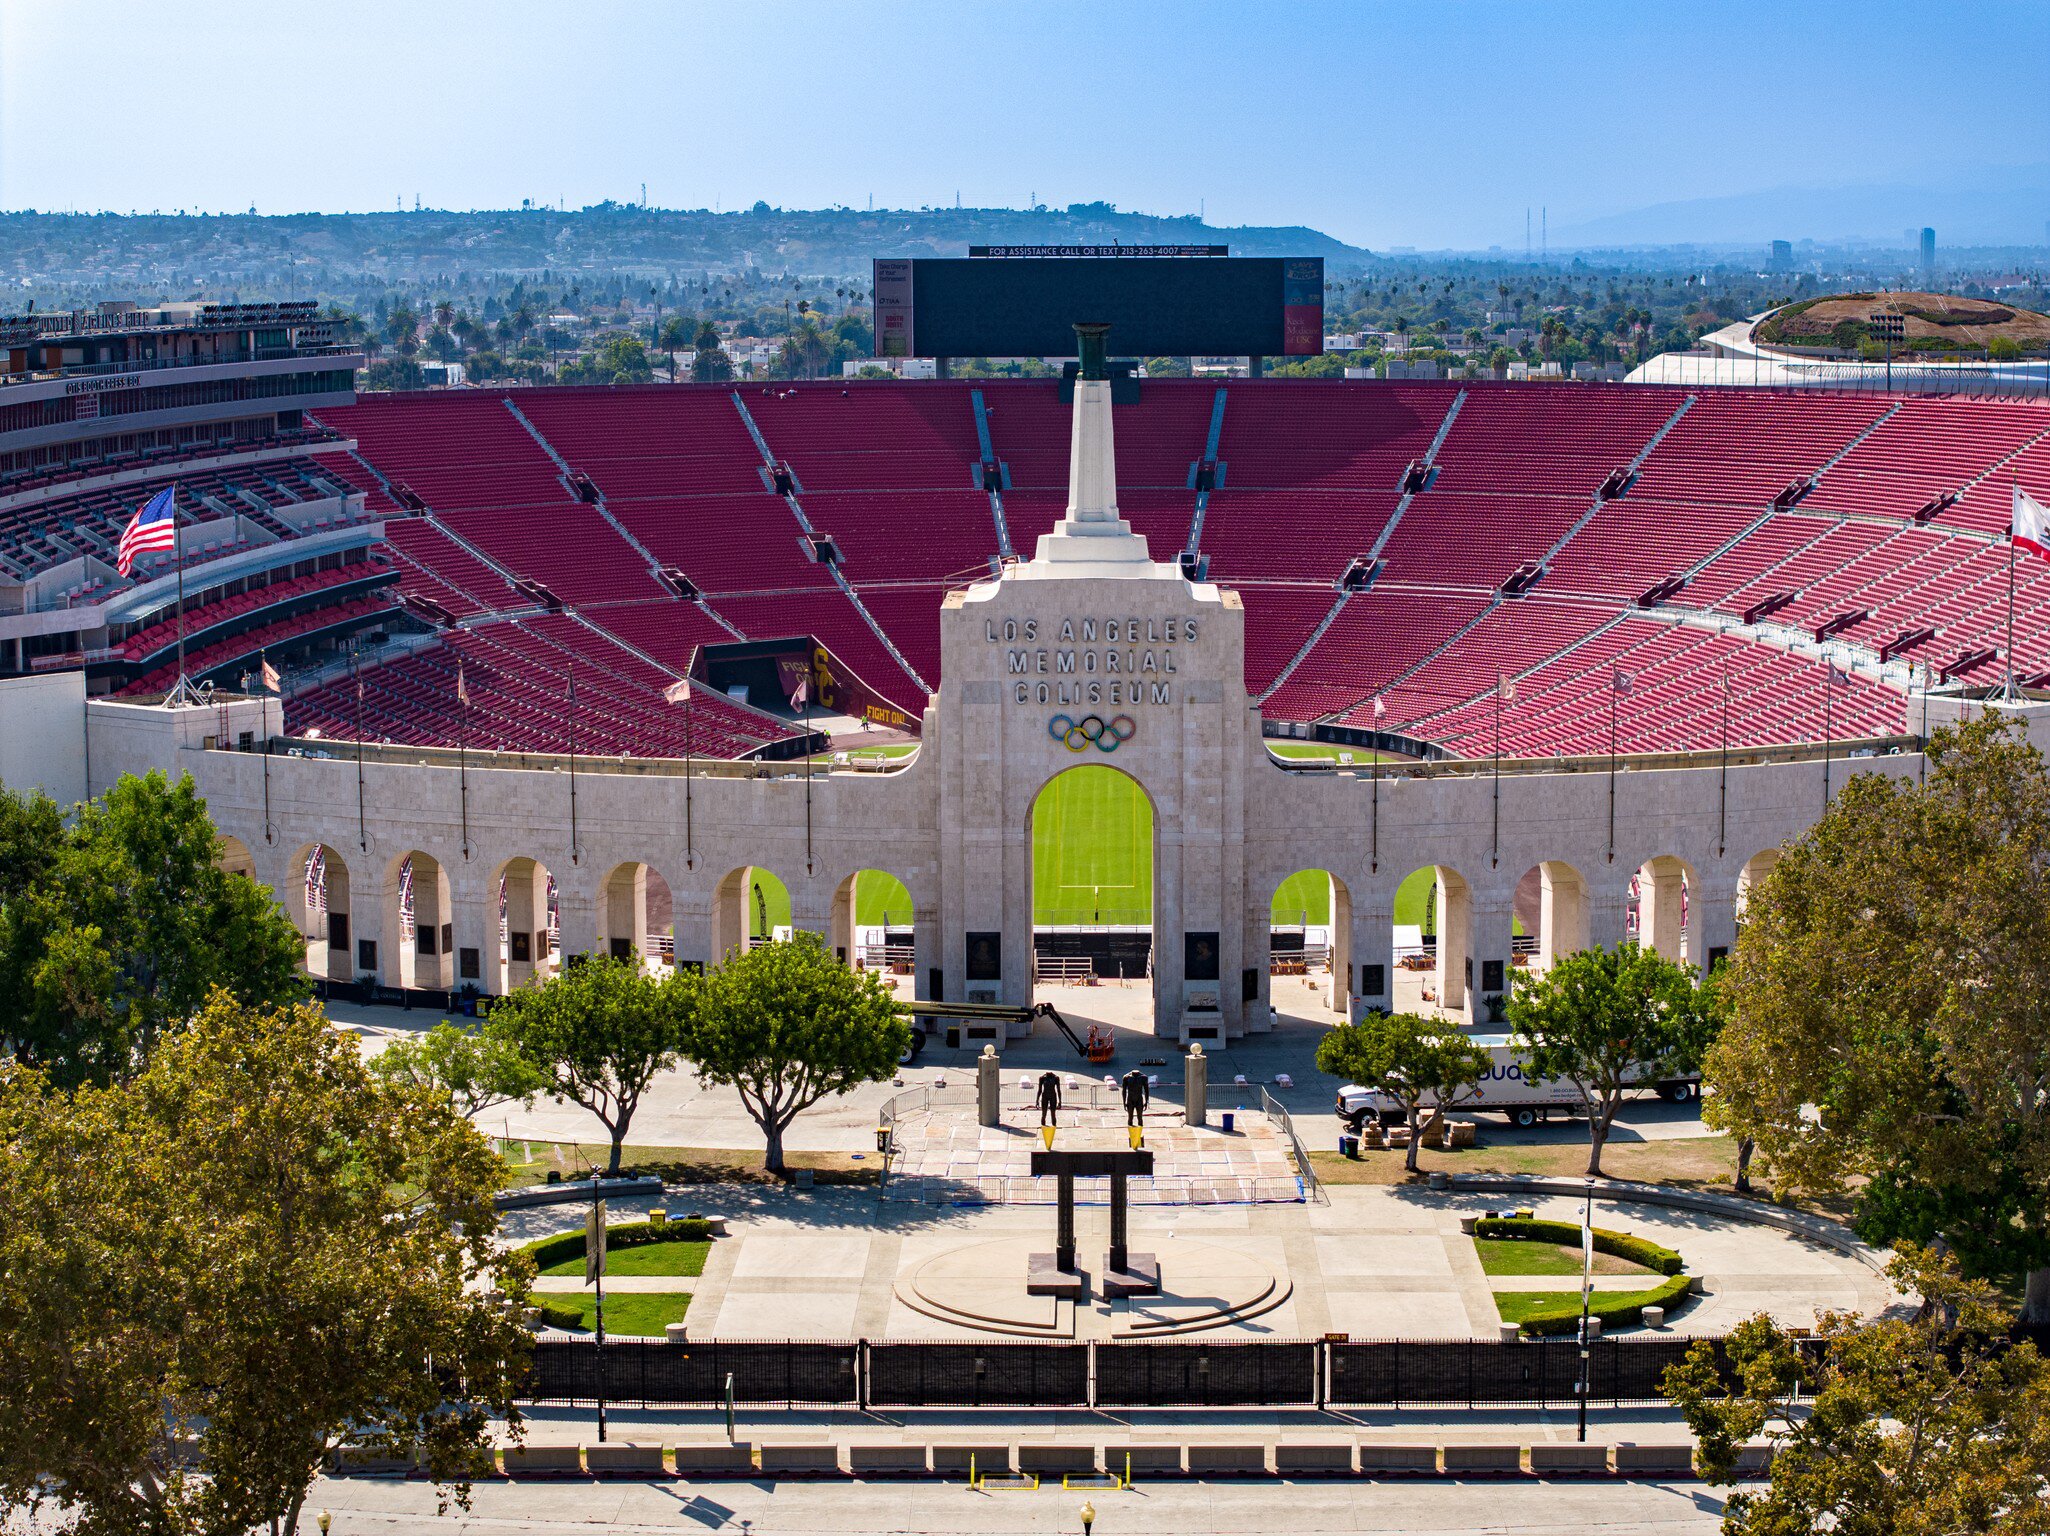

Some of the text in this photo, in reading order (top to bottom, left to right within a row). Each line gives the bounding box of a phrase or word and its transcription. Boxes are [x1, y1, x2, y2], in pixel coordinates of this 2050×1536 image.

[989, 247, 1179, 255] FOR ASSISTANCE CALL OR TEXT 213-263-4007
[1287, 317, 1305, 325] Keck
[1296, 335, 1313, 344] USC
[66, 375, 141, 394] OTIS BOOTH PRESS BOX
[986, 618, 1198, 643] LOS ANGELES
[1008, 649, 1176, 674] MEMORIAL
[1015, 681, 1170, 706] COLISEUM
[867, 705, 905, 724] FIGHT ON!
